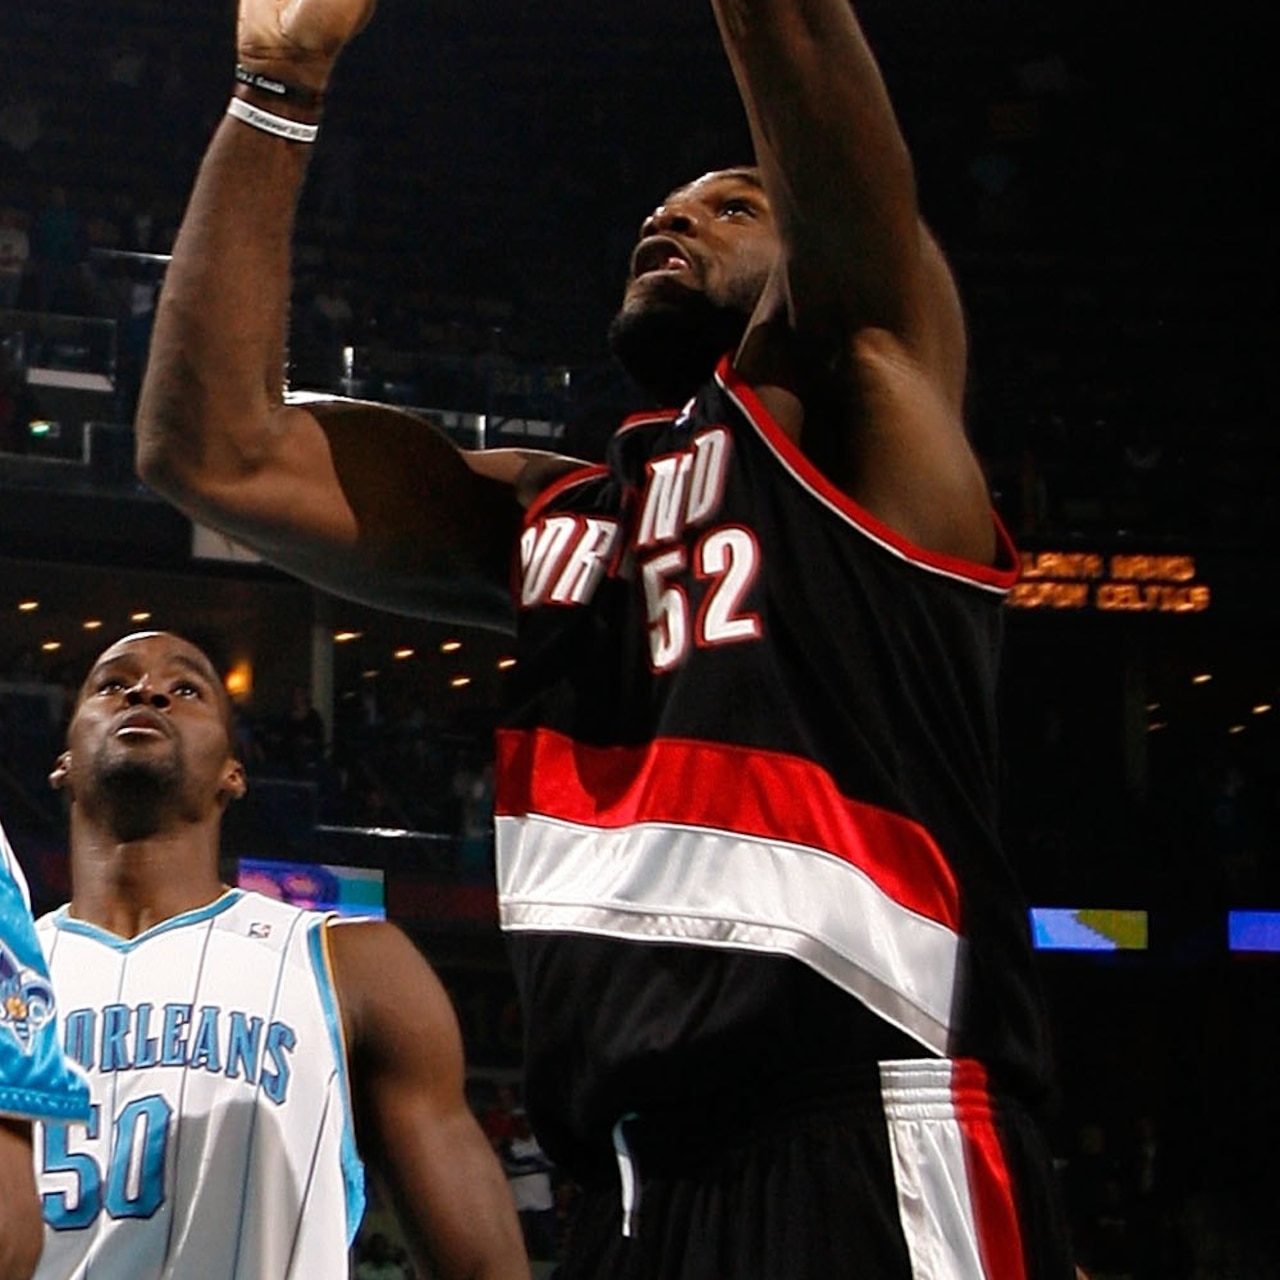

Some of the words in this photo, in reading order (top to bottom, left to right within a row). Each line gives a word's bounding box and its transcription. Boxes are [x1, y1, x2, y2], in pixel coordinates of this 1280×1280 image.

[639, 523, 762, 674] 52
[63, 1003, 298, 1106] ORLEANS
[33, 1092, 173, 1231] 50
